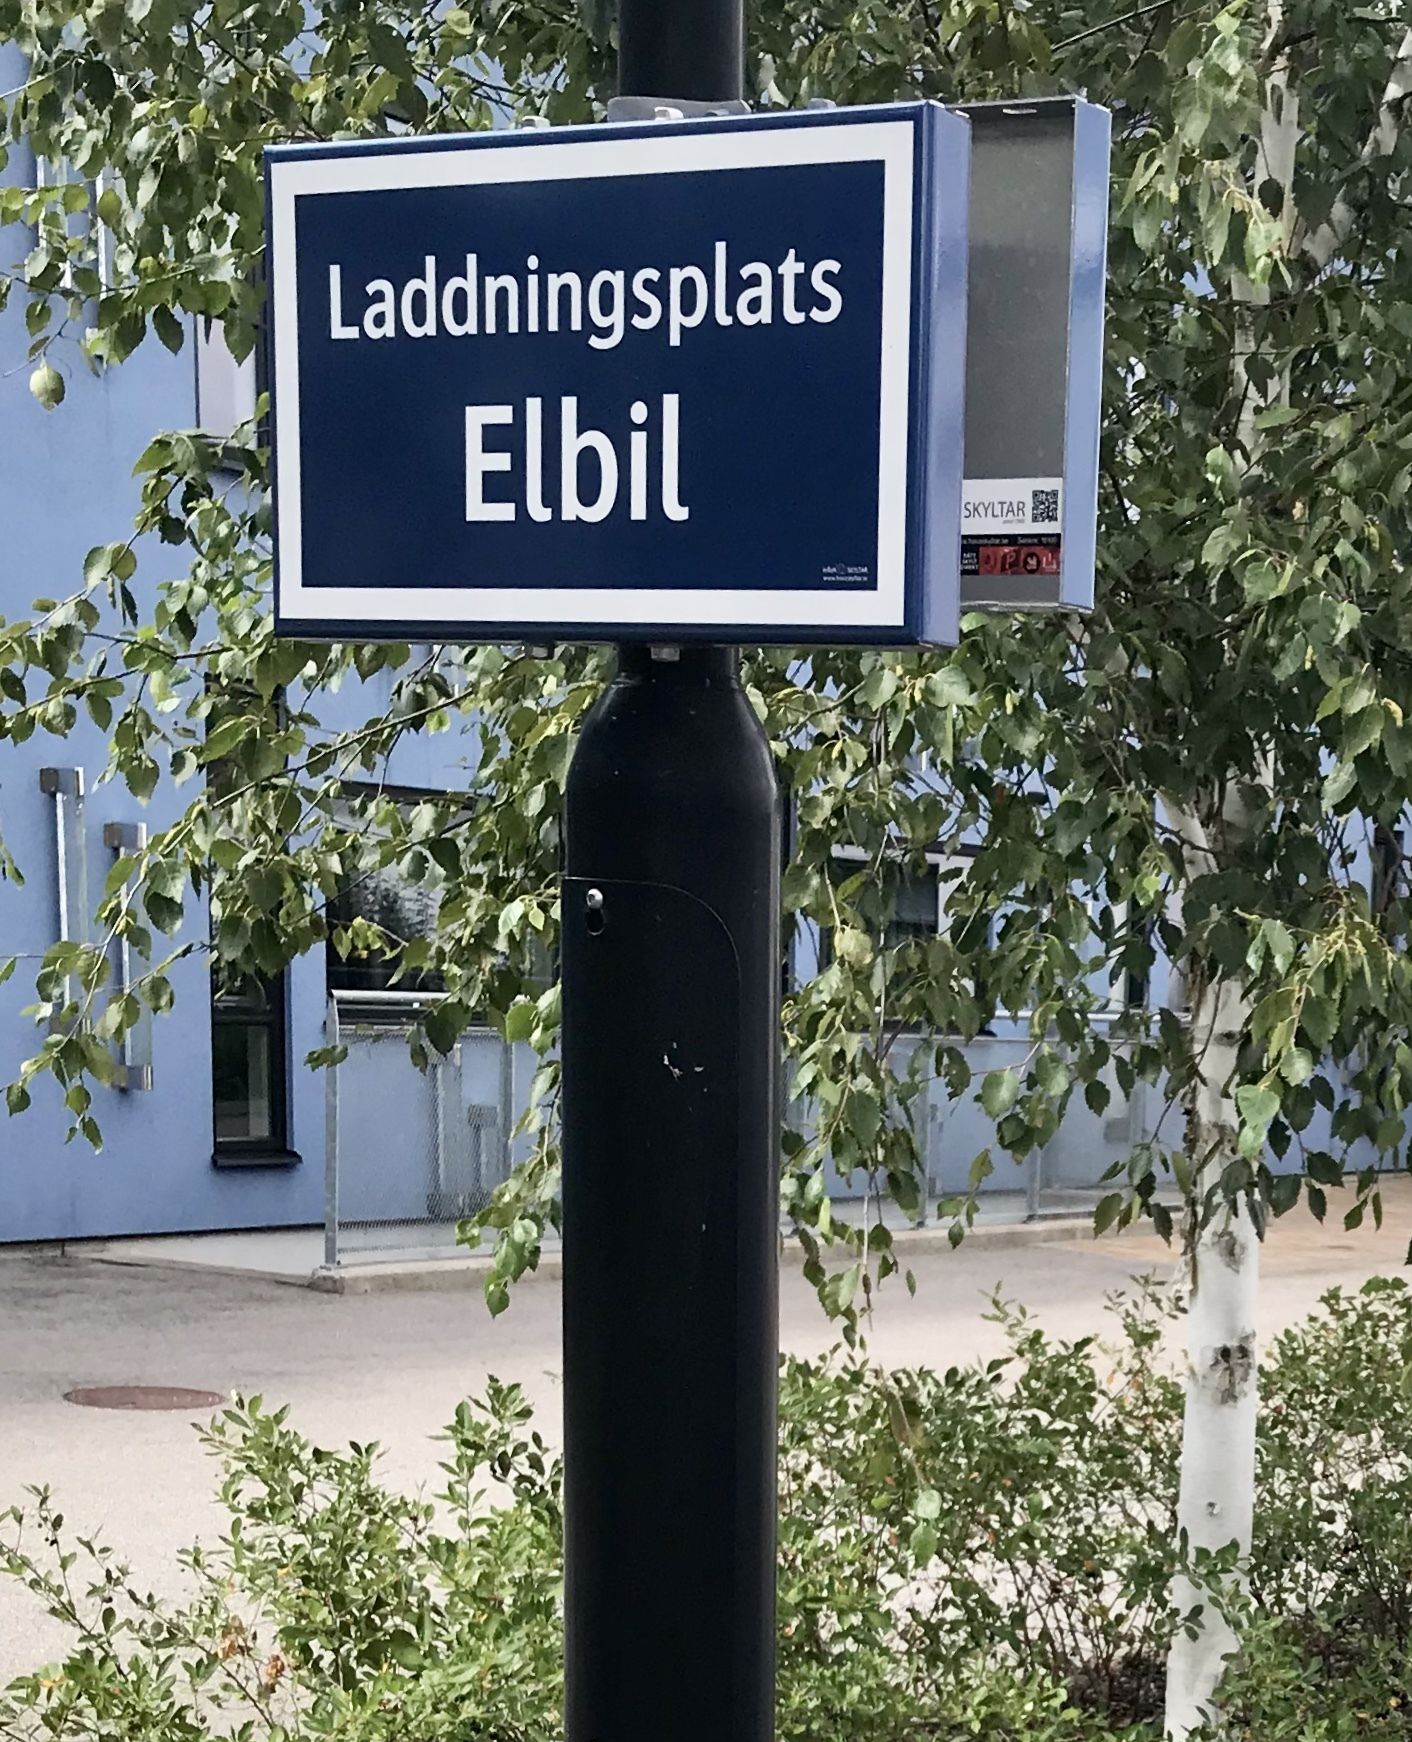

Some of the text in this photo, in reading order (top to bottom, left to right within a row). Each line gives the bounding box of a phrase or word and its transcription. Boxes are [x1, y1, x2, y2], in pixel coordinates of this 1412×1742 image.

[329, 241, 843, 350] Laddningsplats
[465, 393, 690, 523] Elbil
[963, 501, 1026, 519] SKYLTAR
